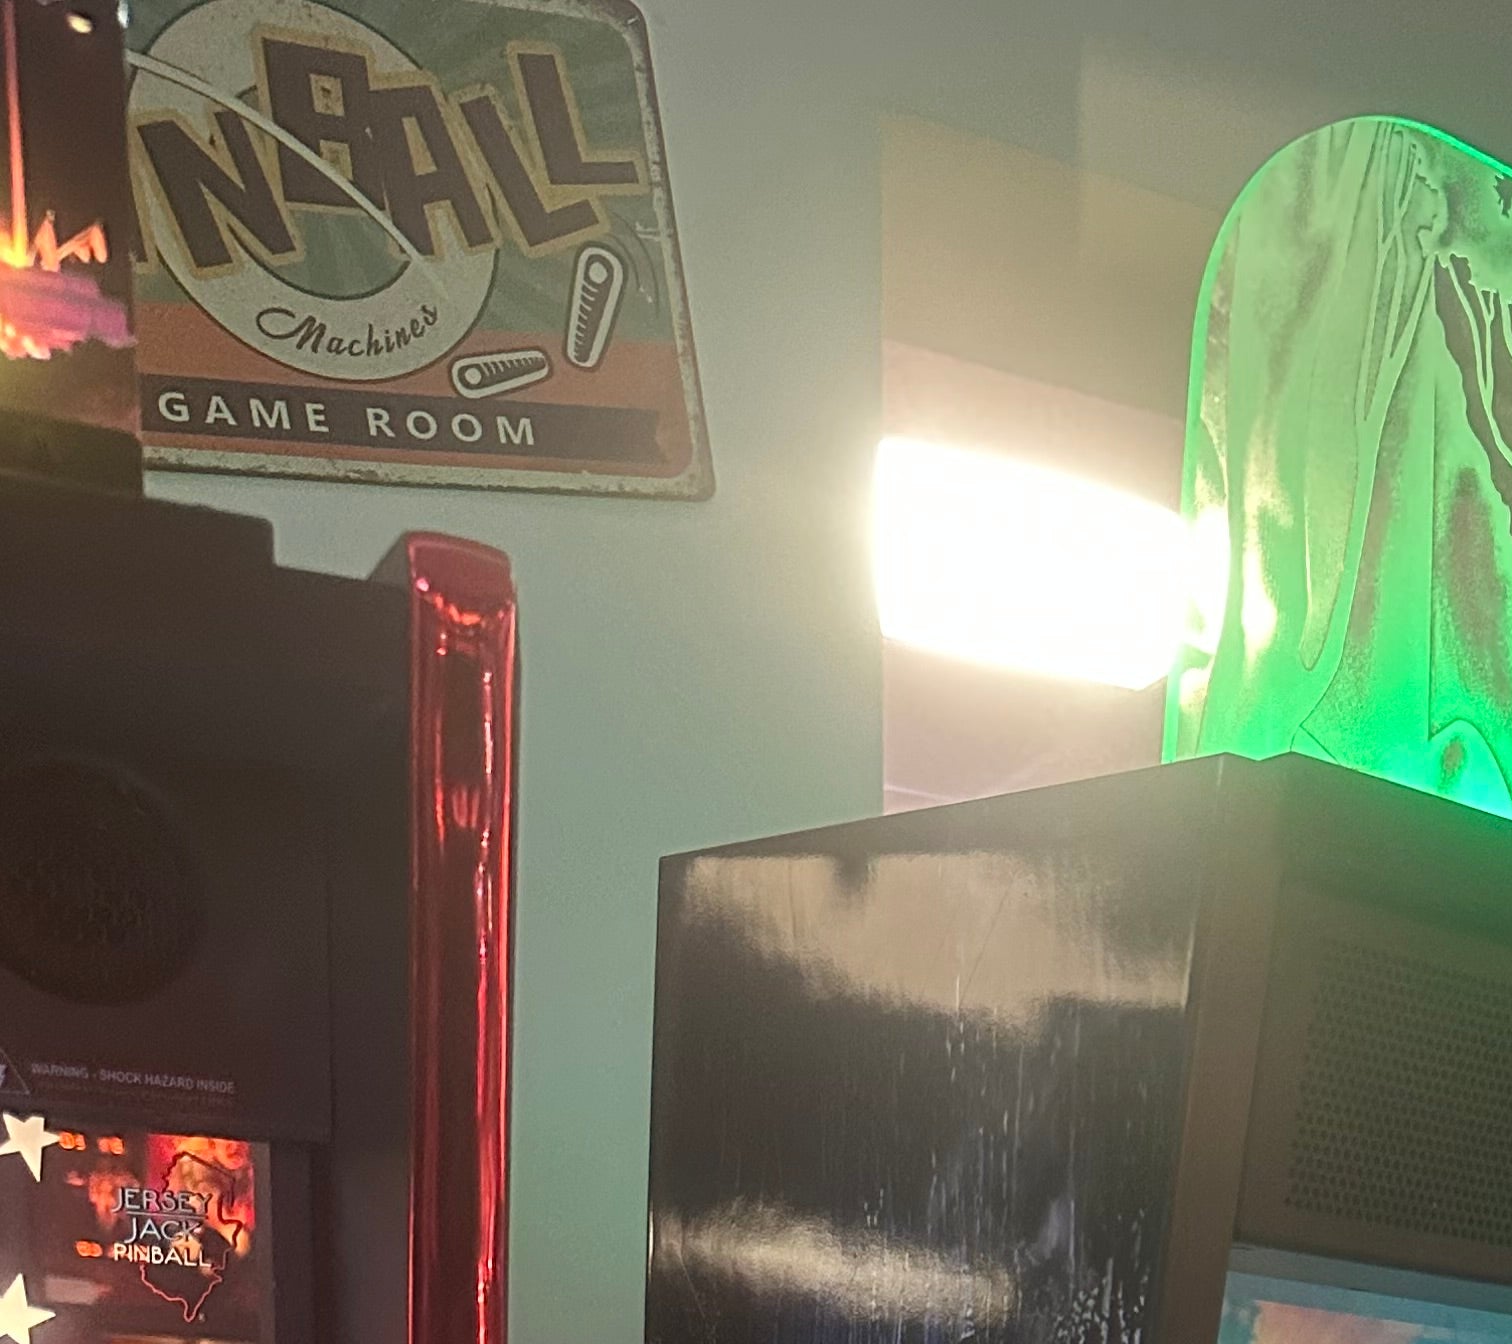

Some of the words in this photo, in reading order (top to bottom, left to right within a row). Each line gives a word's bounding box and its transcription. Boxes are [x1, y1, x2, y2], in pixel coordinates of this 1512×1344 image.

[130, 33, 644, 273] NBALL
[256, 303, 438, 358] Machines
[157, 390, 331, 433] GAME
[366, 406, 537, 446] ROOM
[32, 1062, 89, 1079] WARNING
[99, 1068, 141, 1084] SHOCK
[145, 1075, 194, 1091] HAZARD
[197, 1079, 236, 1095] INSIDE
[111, 1188, 213, 1215] JERSEY
[124, 1218, 201, 1244] JACK
[113, 1242, 214, 1268] PINBALL
